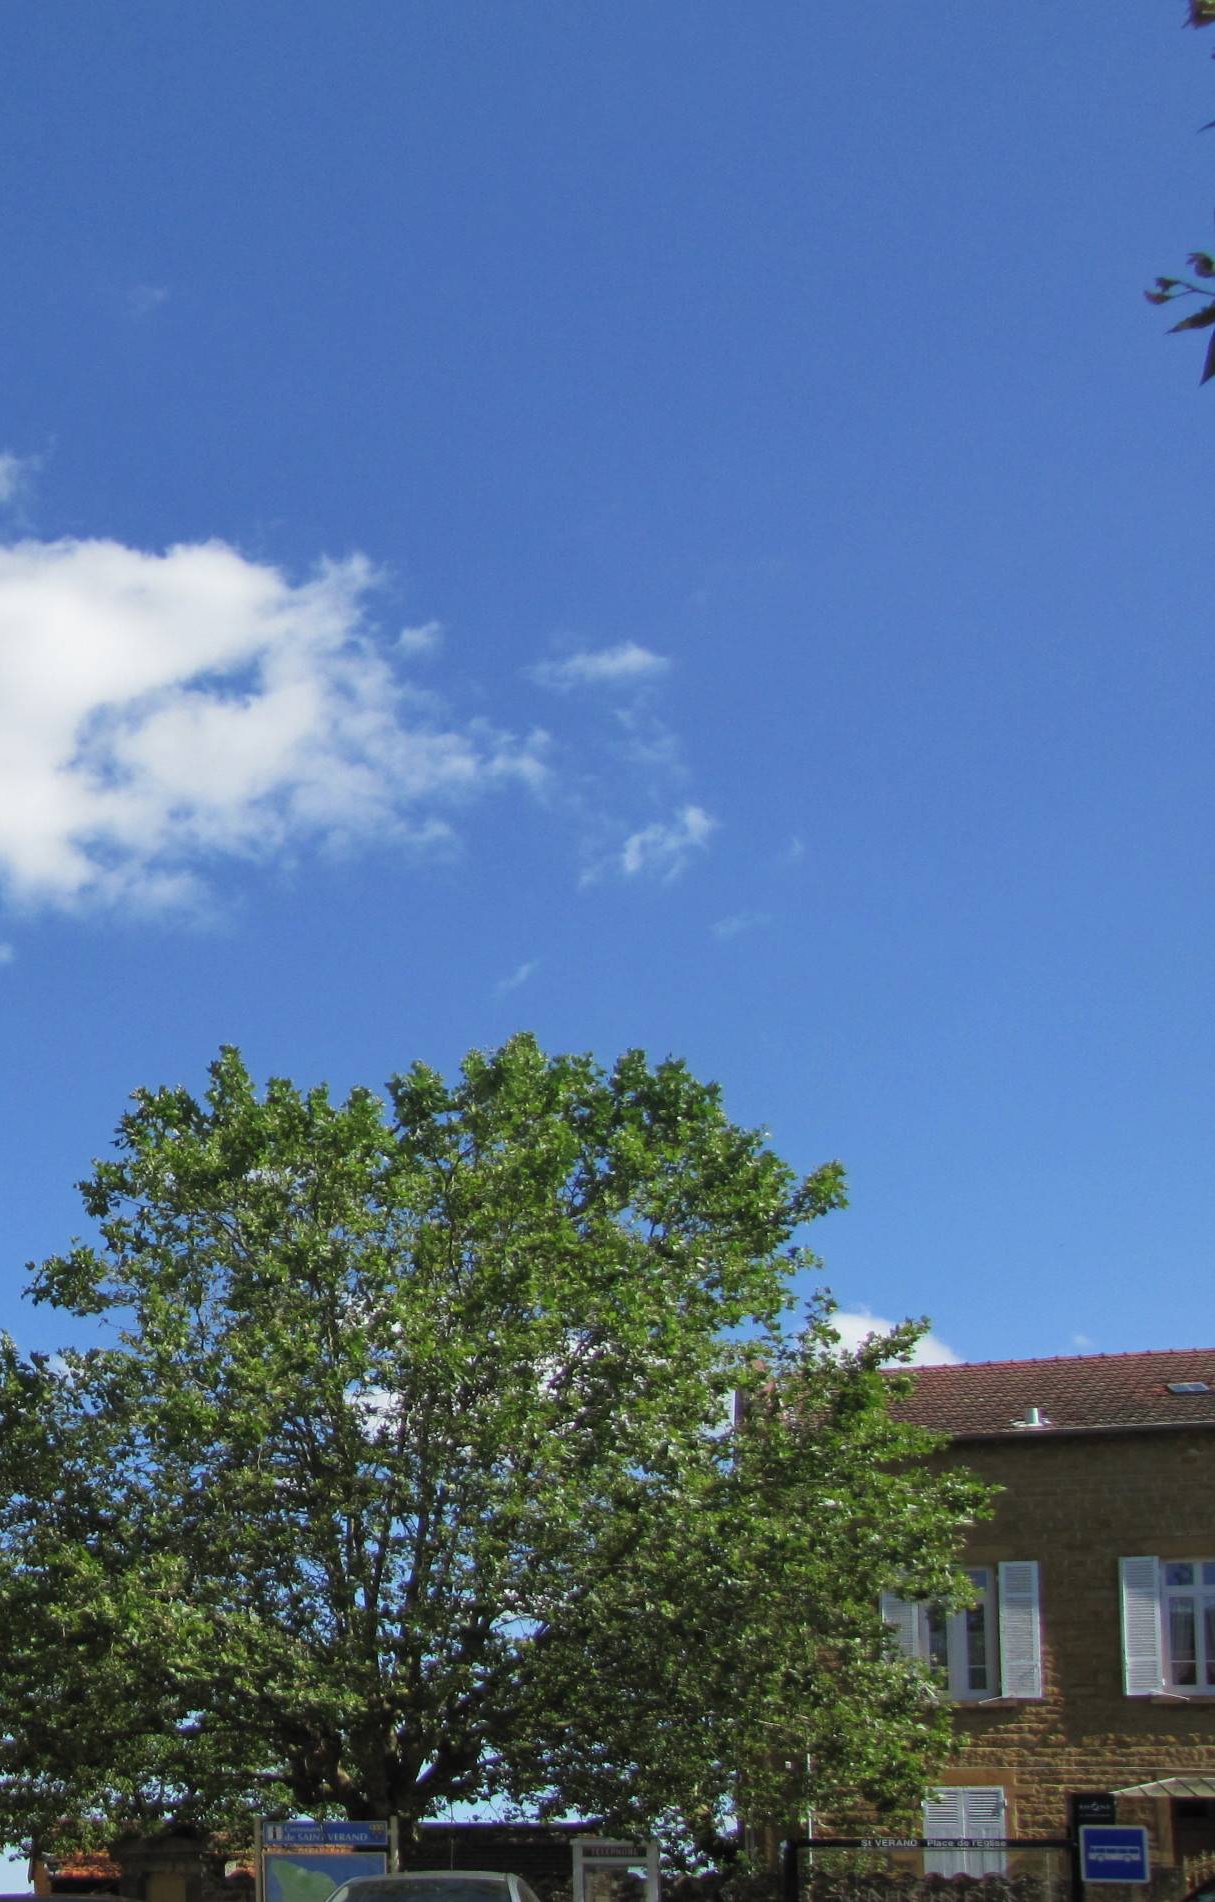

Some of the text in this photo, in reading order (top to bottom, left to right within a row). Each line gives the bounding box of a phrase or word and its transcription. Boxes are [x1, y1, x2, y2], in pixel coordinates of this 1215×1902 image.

[327, 1833, 368, 1841] VERAND
[875, 1839, 918, 1847] VERAND
[927, 1839, 954, 1847] Place
[957, 1839, 970, 1847] de
